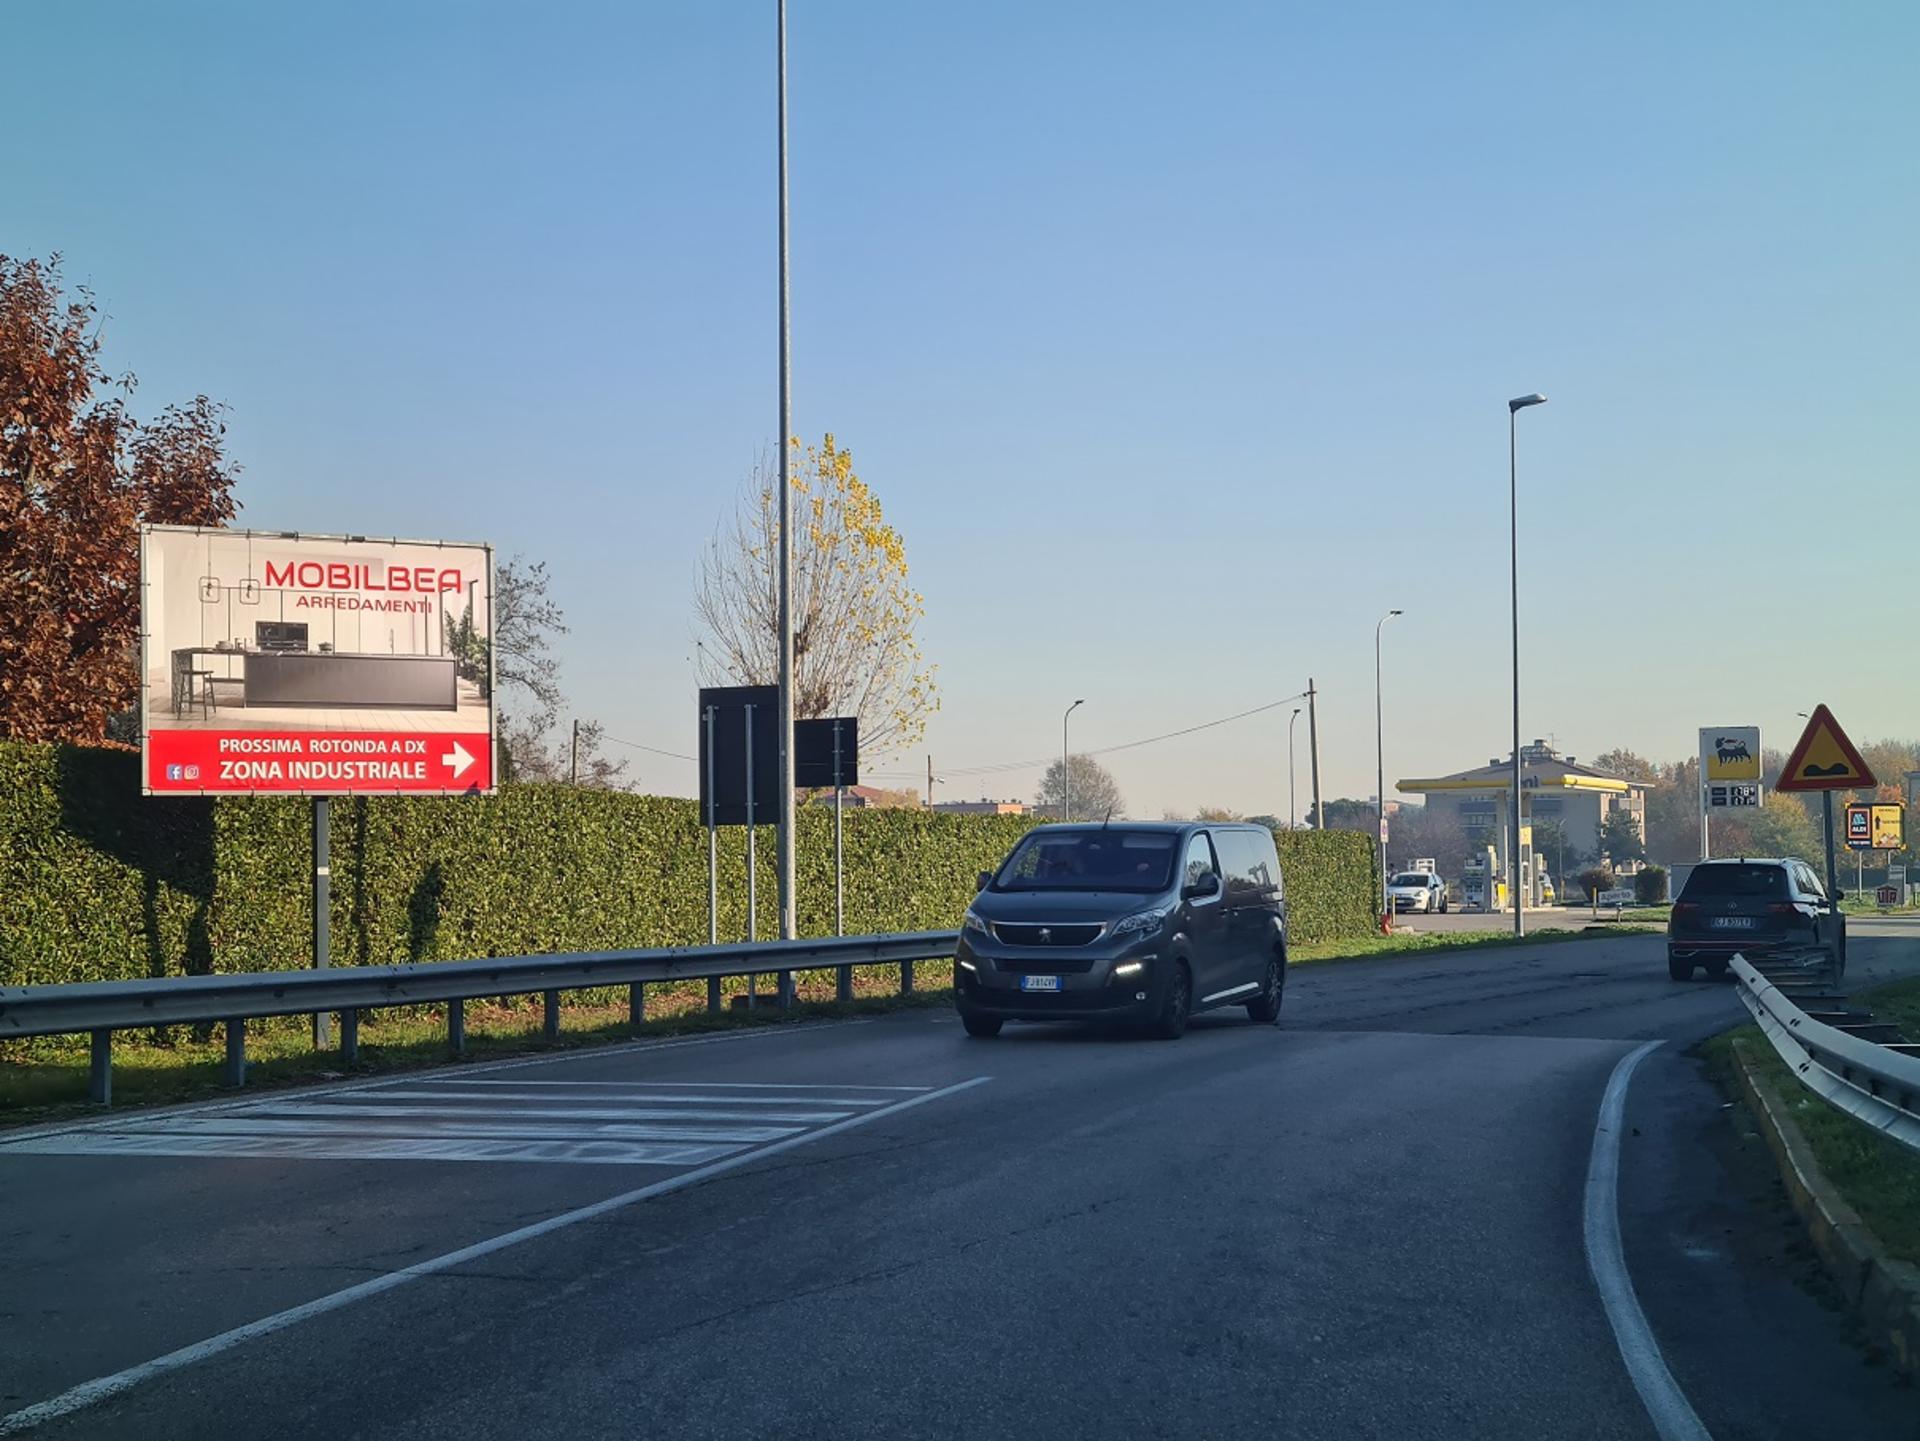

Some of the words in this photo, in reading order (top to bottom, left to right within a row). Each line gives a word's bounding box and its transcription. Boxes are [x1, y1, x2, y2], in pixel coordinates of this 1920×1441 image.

[265, 560, 461, 594] MOBILBEA
[296, 595, 432, 613] ARREDAMENTI
[219, 738, 302, 753] PROSSIMA
[309, 739, 387, 753] ROTONDA
[390, 740, 402, 753] A
[405, 740, 426, 753] DX
[219, 761, 283, 779] ZONA
[288, 761, 426, 780] INDUSTRIALE
